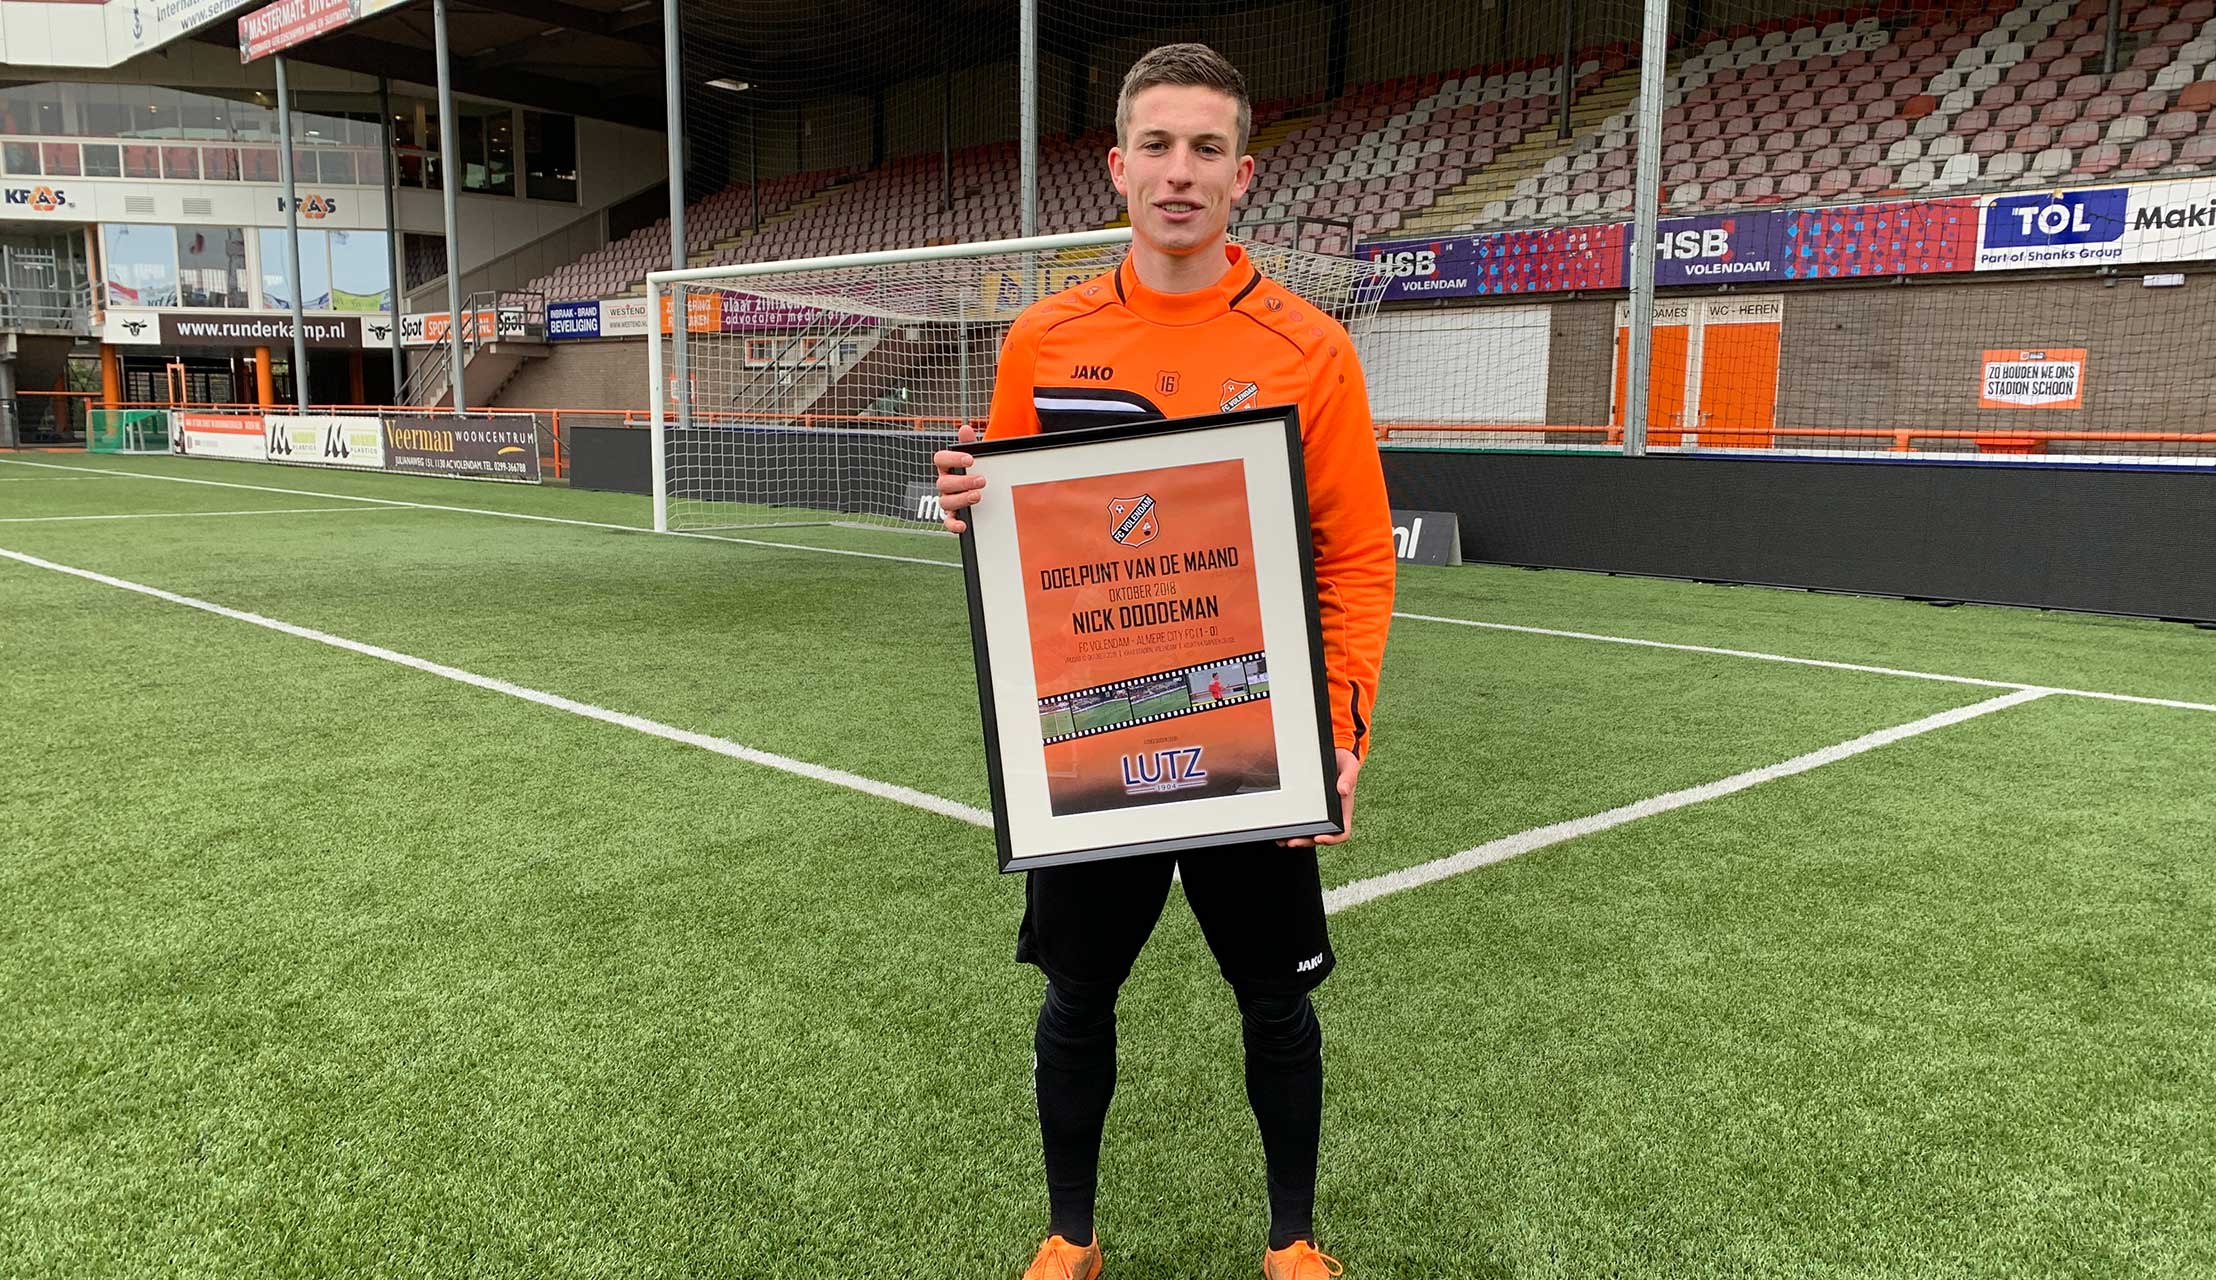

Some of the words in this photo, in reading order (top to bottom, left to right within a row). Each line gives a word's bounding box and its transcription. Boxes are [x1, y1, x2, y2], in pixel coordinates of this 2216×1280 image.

[249, 0, 306, 40] MASTERMATE
[4, 187, 67, 205] KRAS
[2012, 203, 2091, 236] TOL
[1374, 250, 1436, 278] HSB
[1981, 253, 2008, 264] Part
[2008, 252, 2026, 263] of
[2028, 249, 2075, 262] Shanks
[2078, 247, 2122, 260] Group
[1684, 260, 1771, 276] VOLENDAM
[1402, 278, 1468, 291] VOLENDAM
[577, 306, 598, 318] BRAND
[610, 305, 646, 316] WESTEND
[1709, 305, 1729, 316] WC
[1739, 303, 1779, 315] HEREN
[401, 317, 422, 342] Spot
[550, 317, 598, 334] BEVEILIGING
[1070, 365, 1114, 381] JAKO
[1989, 366, 2001, 379] ZO
[2002, 366, 2039, 379] HOUDEN
[2041, 366, 2054, 379] WE
[2055, 366, 2075, 379] ONS
[1160, 376, 1175, 392] 16
[1987, 381, 2030, 395] STADION
[2031, 381, 2074, 395] SCHOON
[384, 419, 454, 452] Veerman
[455, 430, 534, 444] WOONCENTRUM
[1114, 530, 1125, 542] FC
[1121, 496, 1154, 532] VOLENDAM
[1040, 561, 1120, 591] DOELPUNT
[1123, 556, 1156, 580] VAN
[1159, 553, 1180, 576] DE
[1183, 546, 1239, 573] MAAND
[1108, 584, 1152, 603] OKTOBER
[1153, 580, 1177, 597] 2018
[1072, 607, 1115, 635] NICK
[1118, 594, 1219, 629] DOODEMAN
[1078, 641, 1088, 653] FC
[1089, 636, 1130, 652] VOLENDAM
[1136, 633, 1166, 646] ALMERE
[1166, 629, 1183, 641] CITY
[1184, 628, 1194, 639] FC
[1122, 747, 1206, 785] LUTZ
[1157, 783, 1177, 791] 1904
[1296, 952, 1323, 973] JAKO
